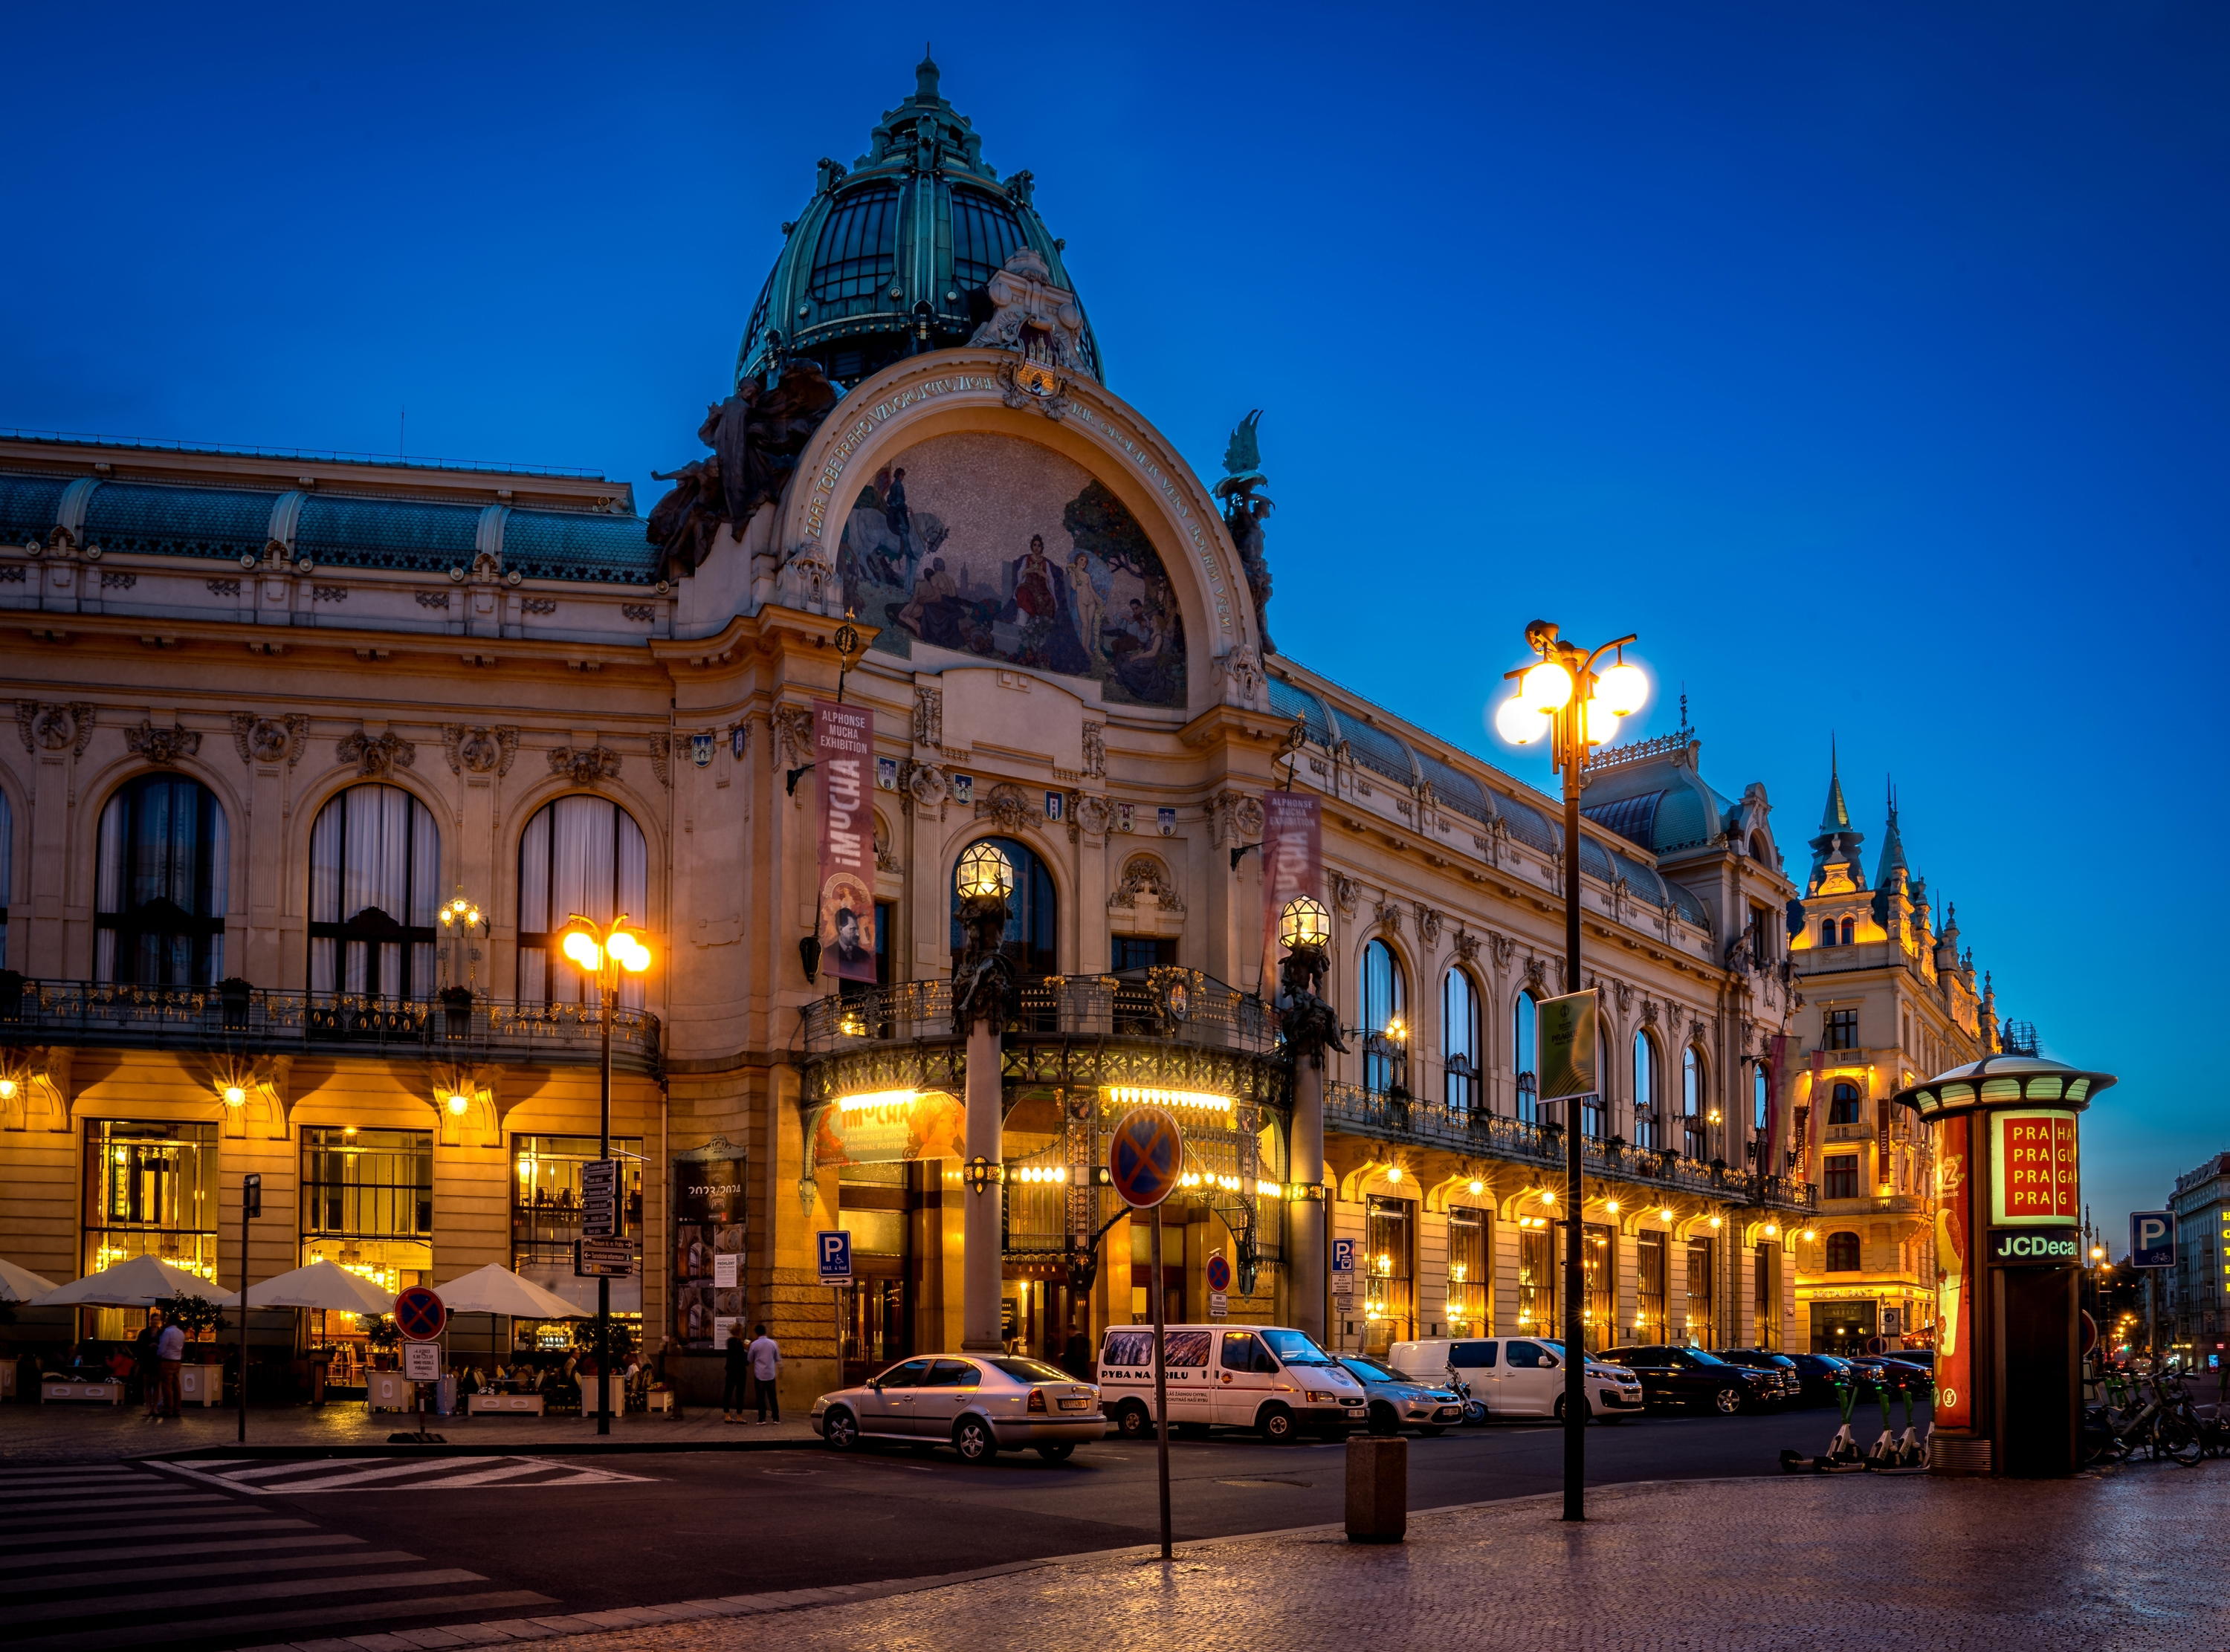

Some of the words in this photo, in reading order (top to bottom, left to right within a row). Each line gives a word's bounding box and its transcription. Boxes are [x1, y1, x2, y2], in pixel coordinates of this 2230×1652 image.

[821, 710, 866, 729] ALPHONSE
[829, 723, 859, 740] MUCHA
[820, 735, 868, 755] EXHIBITION
[1271, 797, 1314, 810] ALPHONSE
[1278, 807, 1308, 817] MUCHA
[2013, 1126, 2049, 1141] PRA
[845, 1144, 876, 1152] ORIGINAL
[1880, 1129, 1888, 1155] HOTEL
[2014, 1148, 2049, 1162] PRA
[2014, 1170, 2050, 1185] PRA
[2014, 1191, 2050, 1205] PRA
[2058, 1191, 2066, 1205] G
[2140, 1224, 2165, 1251] P
[824, 1237, 844, 1263] P
[1336, 1243, 1350, 1262] P
[1813, 1289, 1874, 1298] RESTAURANT
[1135, 1371, 1151, 1379] NA
